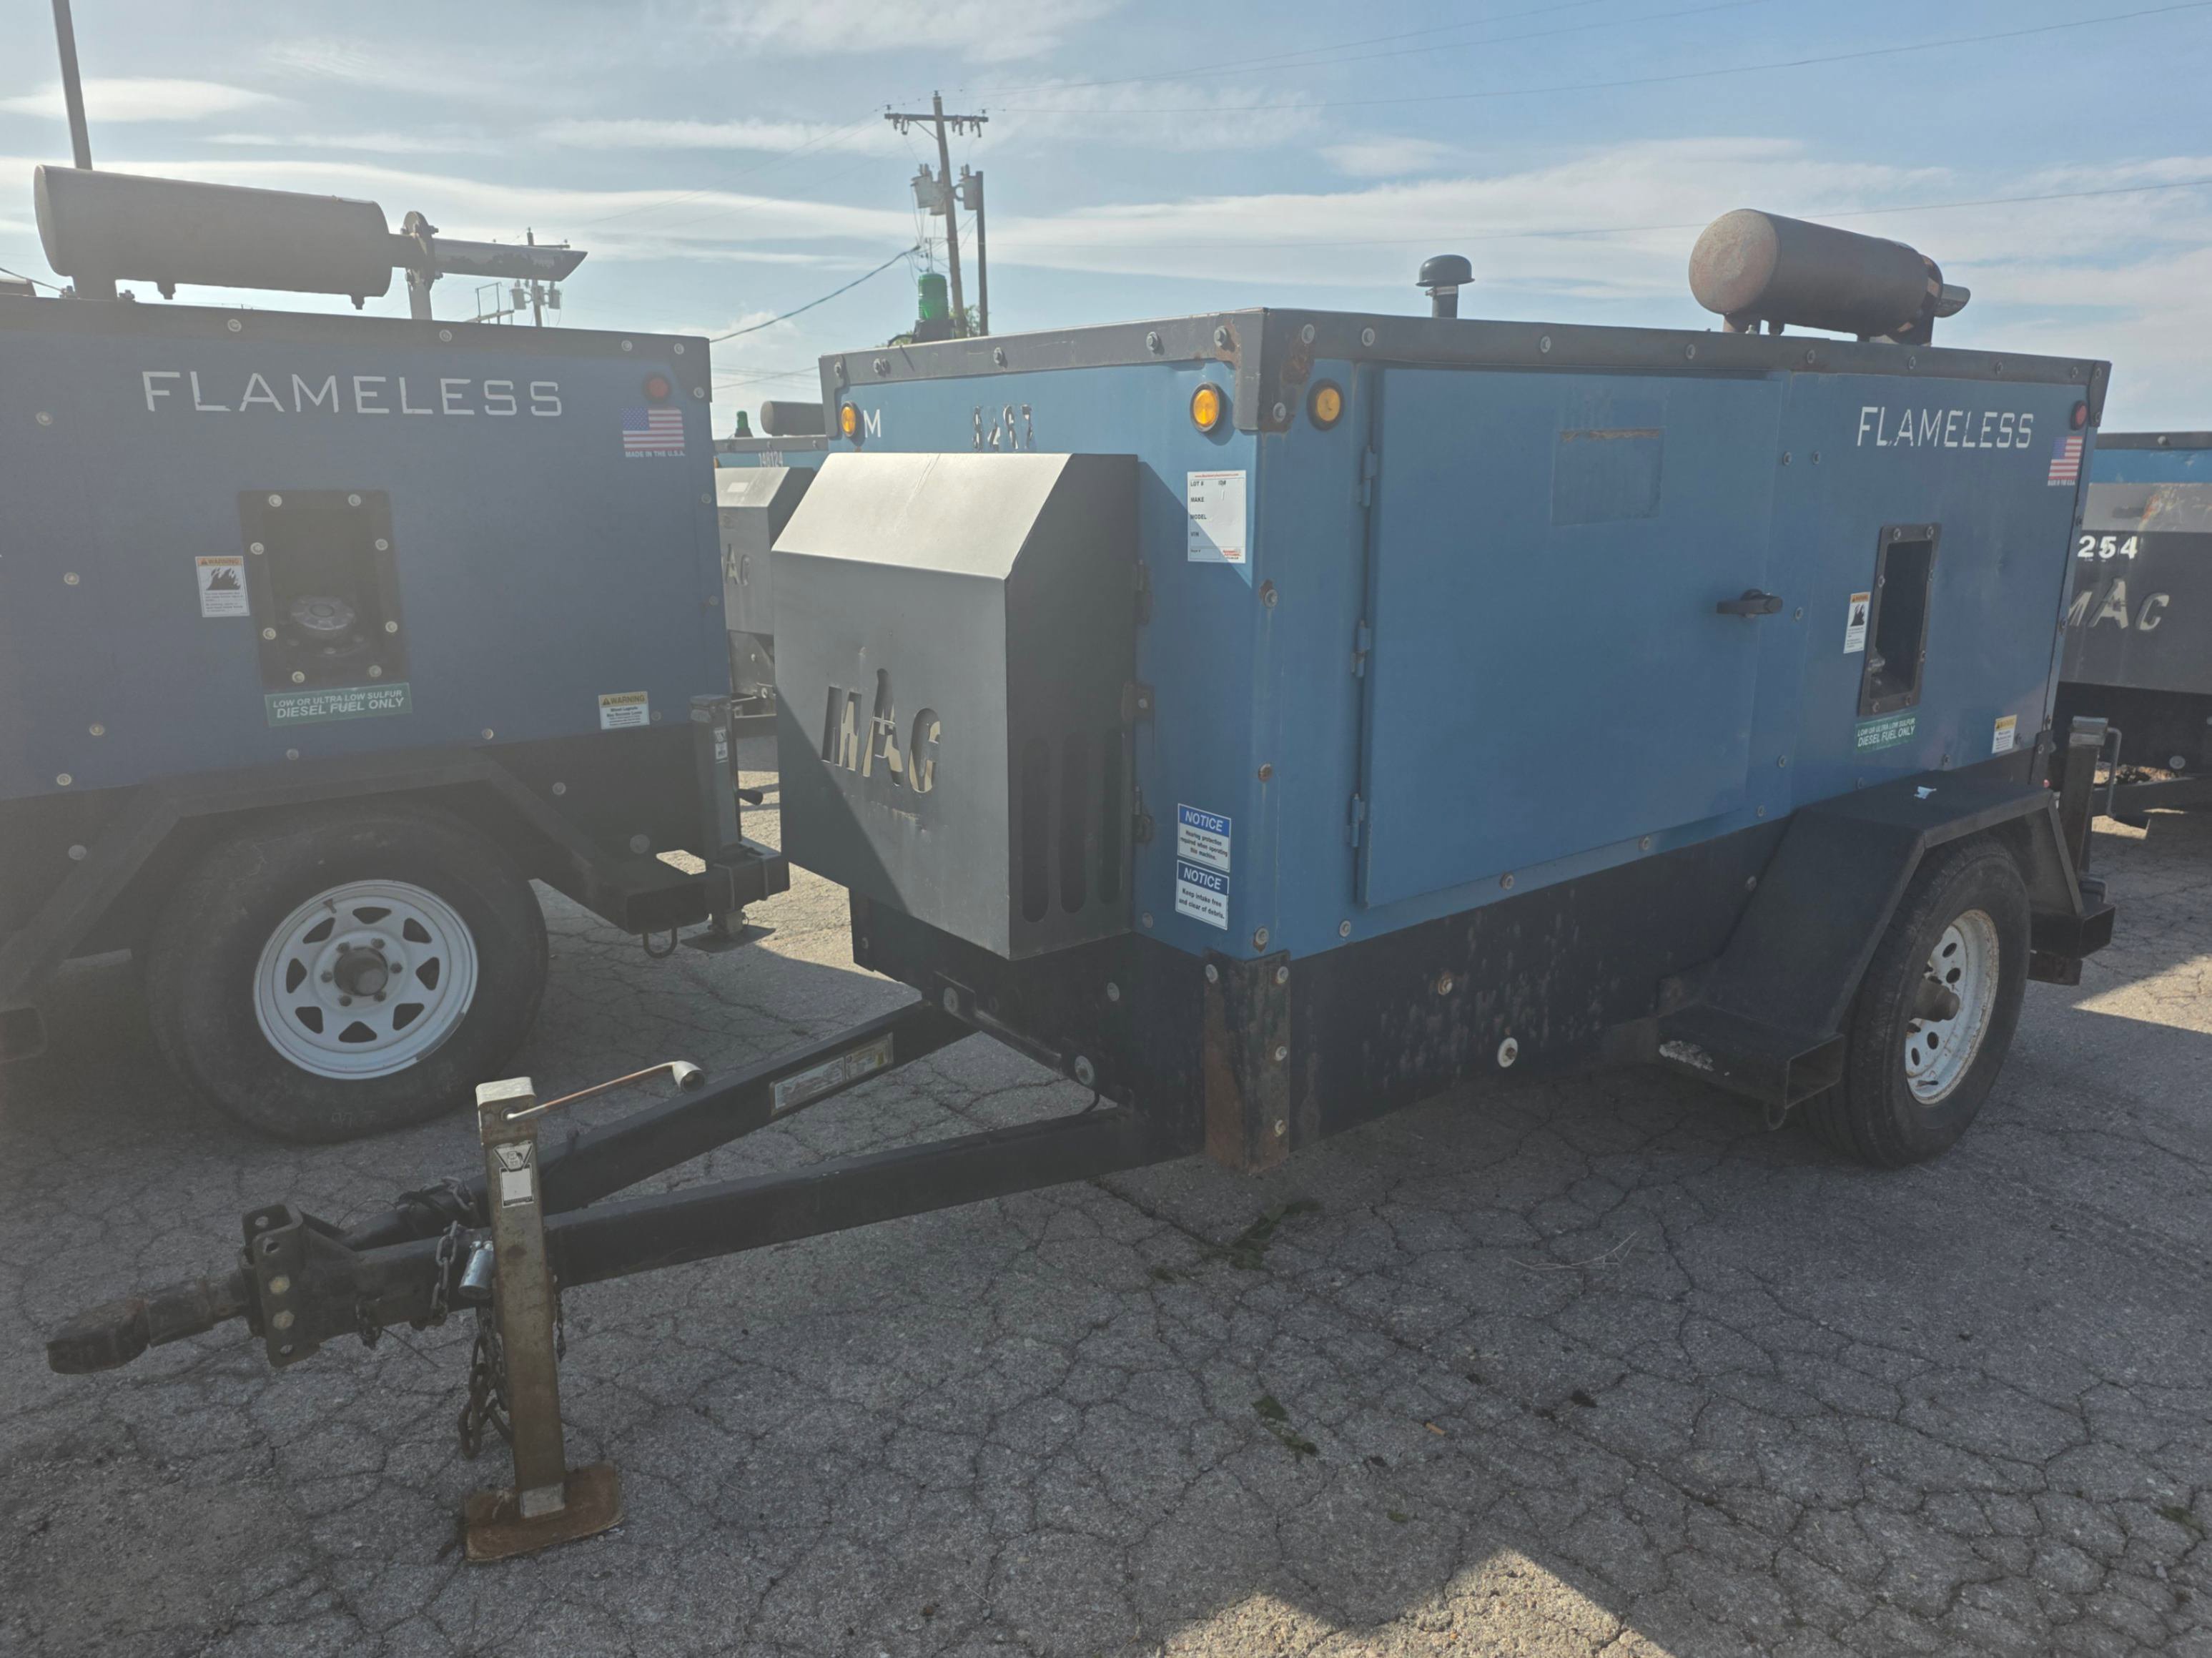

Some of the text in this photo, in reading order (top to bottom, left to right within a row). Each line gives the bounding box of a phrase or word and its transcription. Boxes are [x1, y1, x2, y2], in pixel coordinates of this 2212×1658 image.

[142, 371, 562, 416] FLAMELESS
[864, 409, 881, 438] M
[1857, 406, 2033, 448] FLAMELESS
[2077, 535, 2138, 559] 254
[721, 543, 751, 586] AC
[273, 699, 295, 708] LOW
[313, 696, 342, 704] ULTRA
[345, 692, 365, 701] LOW
[367, 689, 403, 699] SULFUR
[277, 697, 404, 719] DIESEL FUEL ONLY
[611, 695, 645, 704] WARNING
[821, 668, 940, 794] MAC
[1857, 725, 1915, 747] DIESEL FUEL ONLY
[1185, 810, 1223, 832] NOTICE
[1202, 835, 1222, 846] protection
[1209, 845, 1228, 857] operating
[1183, 867, 1222, 890] NOTICE
[1182, 887, 1222, 907] Keep intake free
[1188, 901, 1201, 910] clear
[1208, 908, 1225, 919] debris.
